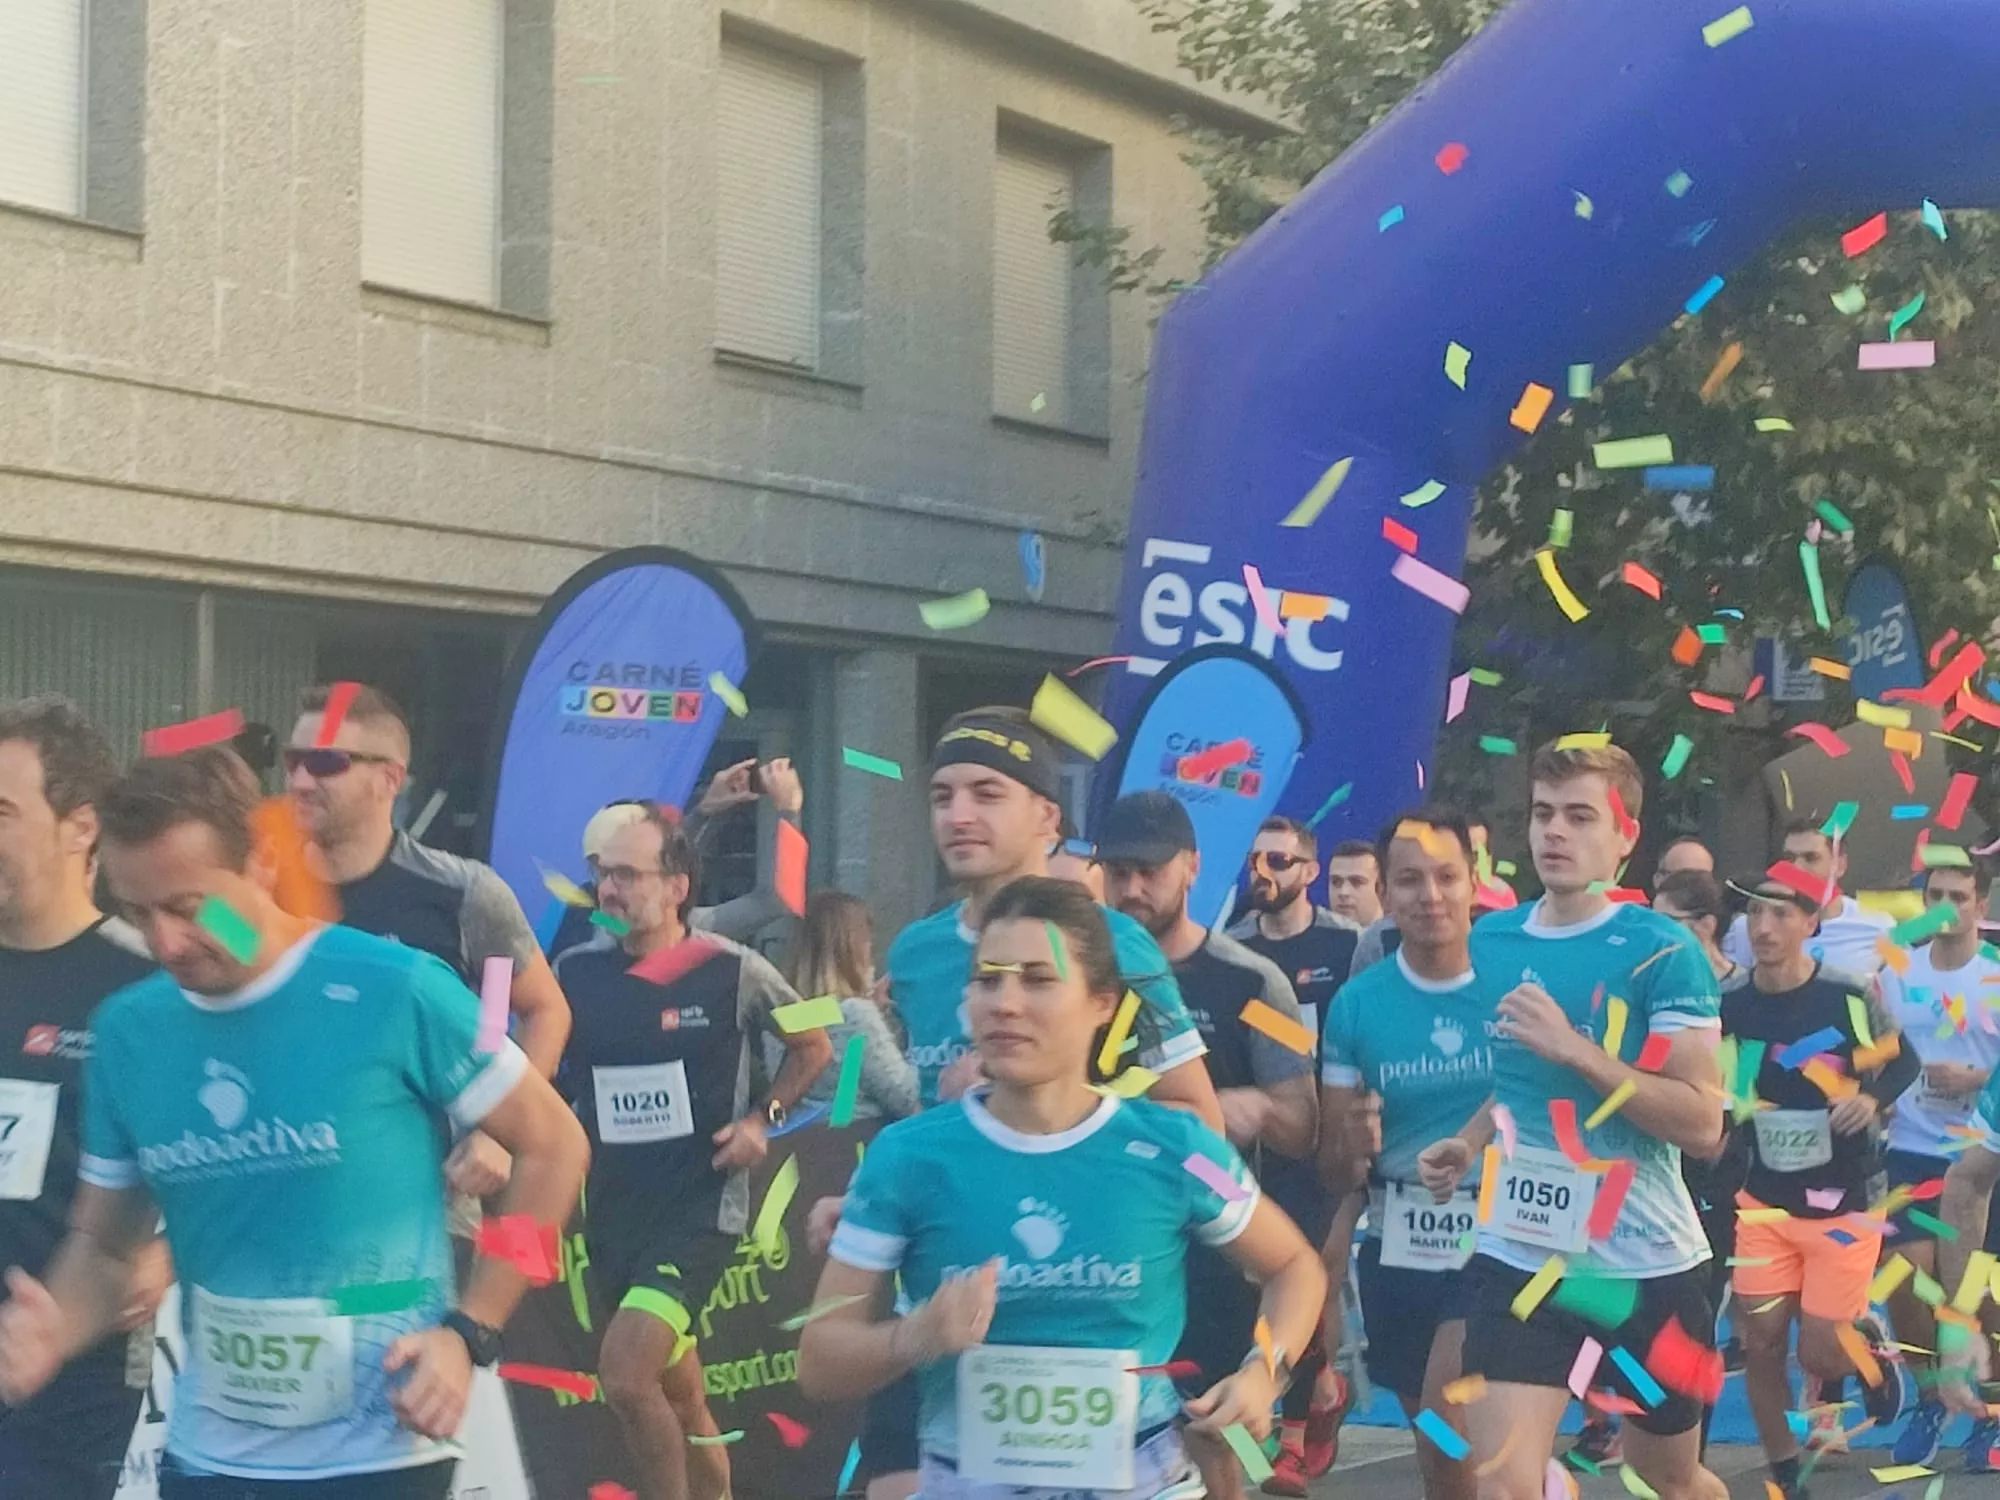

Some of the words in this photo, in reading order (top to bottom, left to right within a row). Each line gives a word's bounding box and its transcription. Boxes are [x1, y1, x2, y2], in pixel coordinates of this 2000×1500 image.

[567, 659, 702, 688] CARNÉ
[565, 689, 699, 717] JOVEN
[611, 1090, 670, 1112] 1020
[1506, 1176, 1570, 1211] 1050
[1403, 1208, 1473, 1234] 1049
[1516, 1208, 1551, 1225] IVAN
[205, 1326, 321, 1372] 3057
[980, 1382, 1115, 1426] 3059
